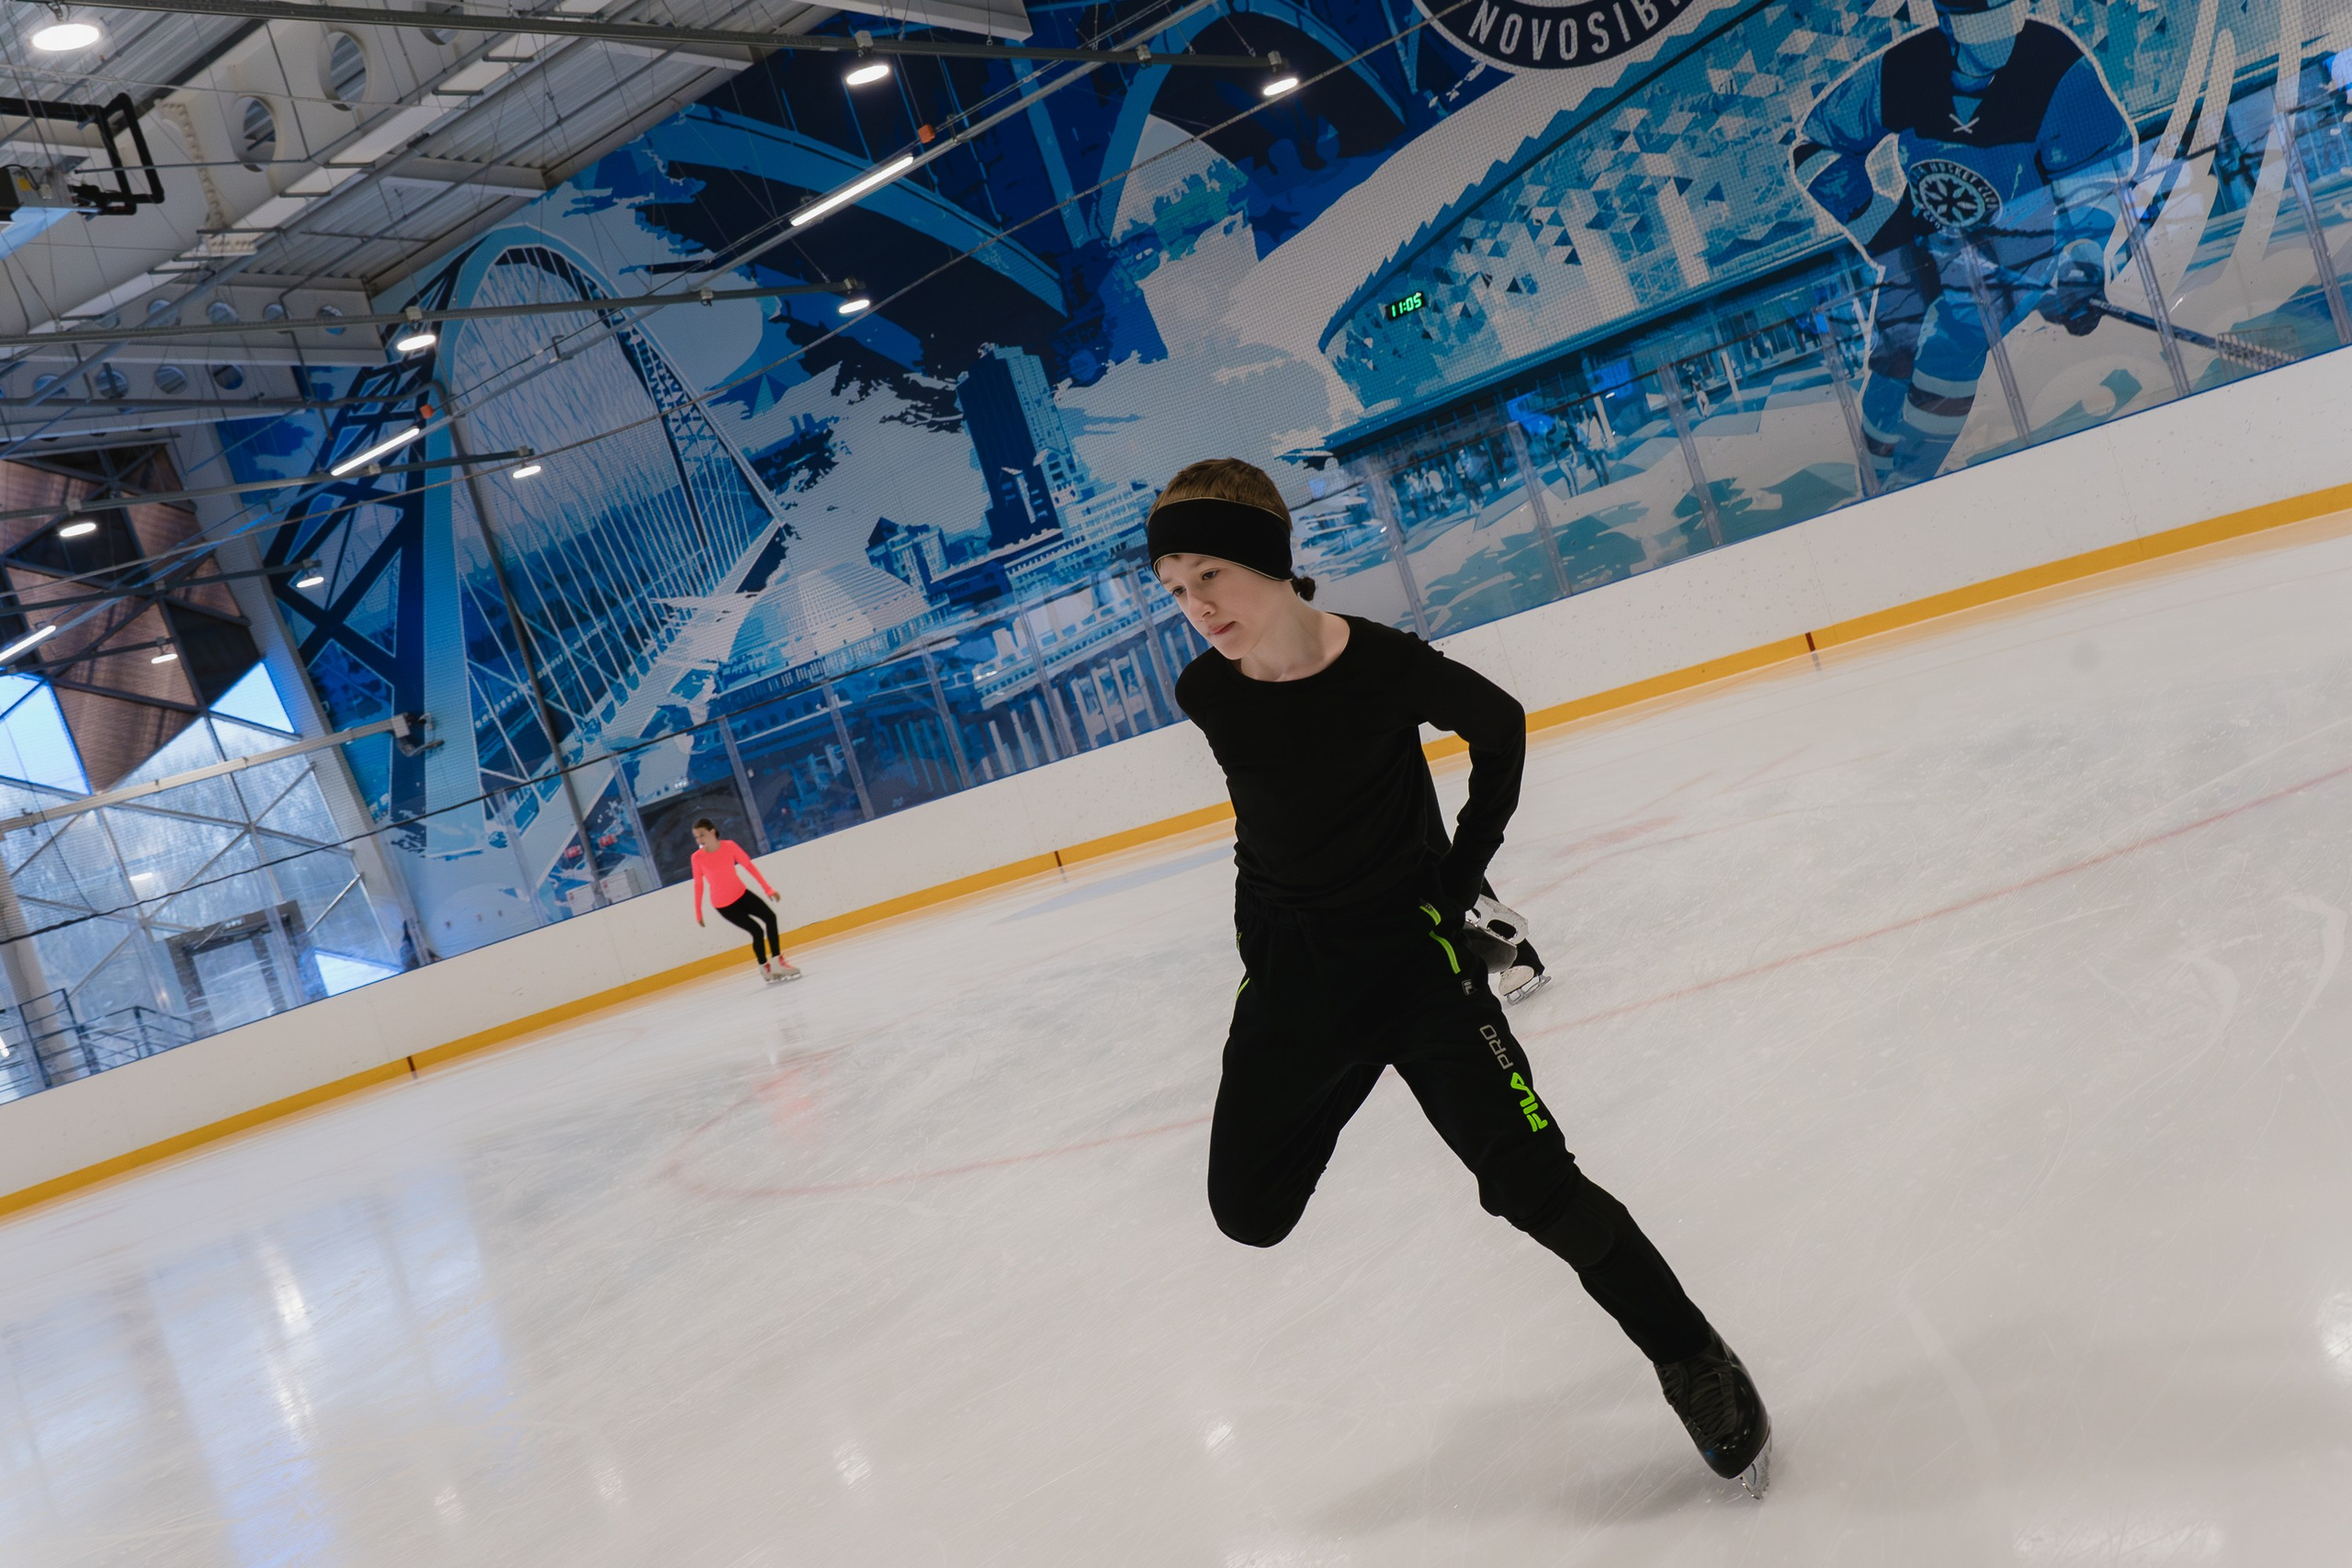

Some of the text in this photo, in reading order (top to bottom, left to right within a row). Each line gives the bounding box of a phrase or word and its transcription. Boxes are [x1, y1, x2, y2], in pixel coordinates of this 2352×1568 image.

[1468, 0, 1680, 61] NOVOSIB
[1391, 292, 1422, 318] 11:05
[1479, 1024, 1548, 1133] FILA PRO
